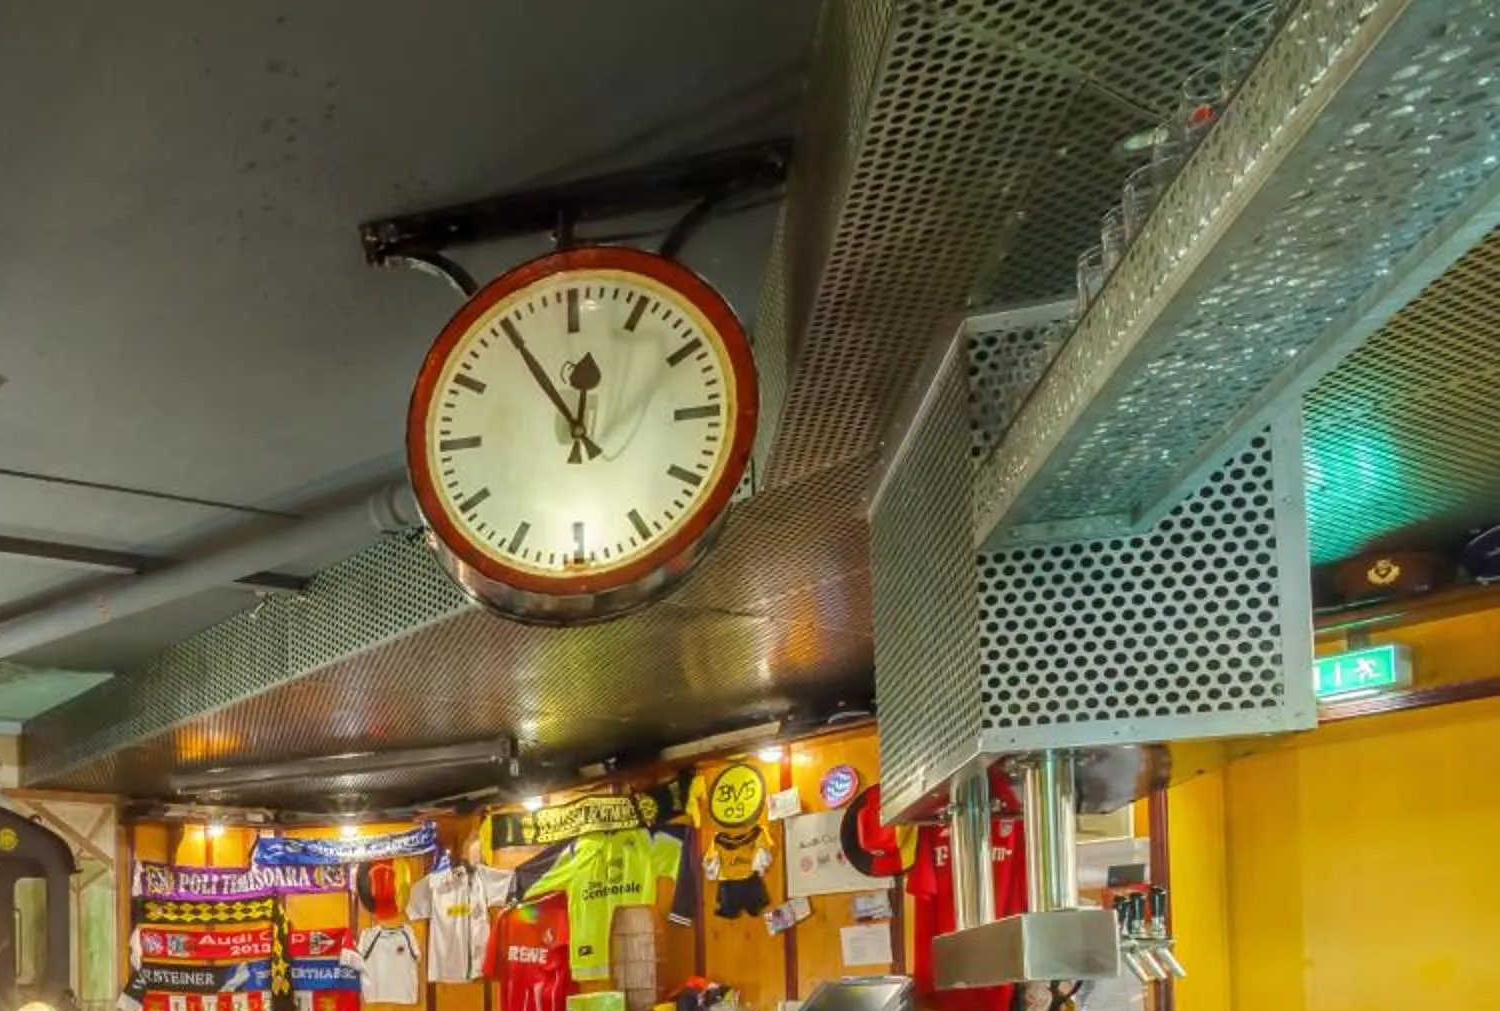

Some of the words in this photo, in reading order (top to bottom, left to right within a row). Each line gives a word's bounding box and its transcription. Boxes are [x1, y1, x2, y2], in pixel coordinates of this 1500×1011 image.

[179, 872, 217, 895] POLI
[198, 932, 253, 945] Audi
[259, 930, 306, 945] Cp
[507, 945, 550, 965] REWE
[134, 969, 215, 988] RSTEINER
